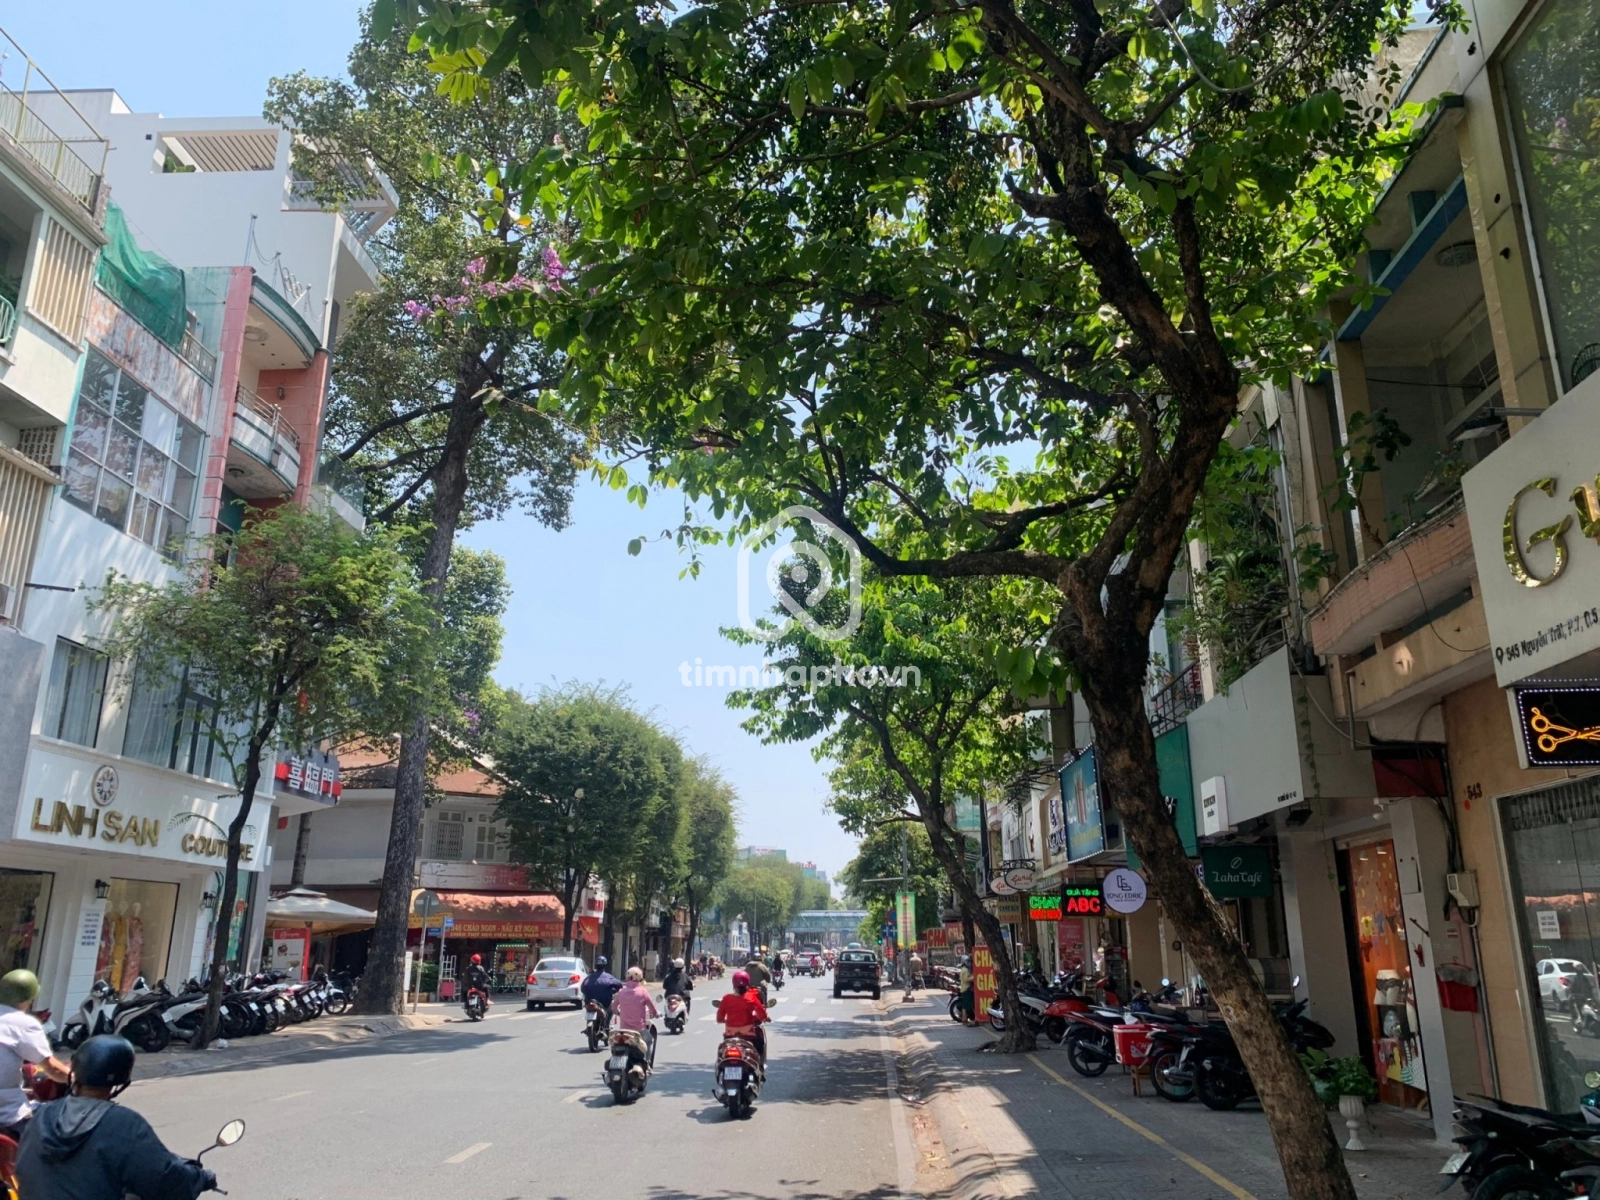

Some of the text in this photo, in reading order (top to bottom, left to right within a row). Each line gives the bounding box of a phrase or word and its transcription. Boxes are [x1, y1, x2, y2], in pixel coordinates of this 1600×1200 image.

[1505, 643, 1520, 662] 545
[289, 755, 335, 798] 喜臨門
[1466, 782, 1483, 801] 543
[31, 797, 254, 862] LINH SAN COUTRE
[1067, 897, 1100, 913] ABC
[1107, 892, 1143, 900] LONG EDRIC
[976, 969, 995, 991] GIÁ
